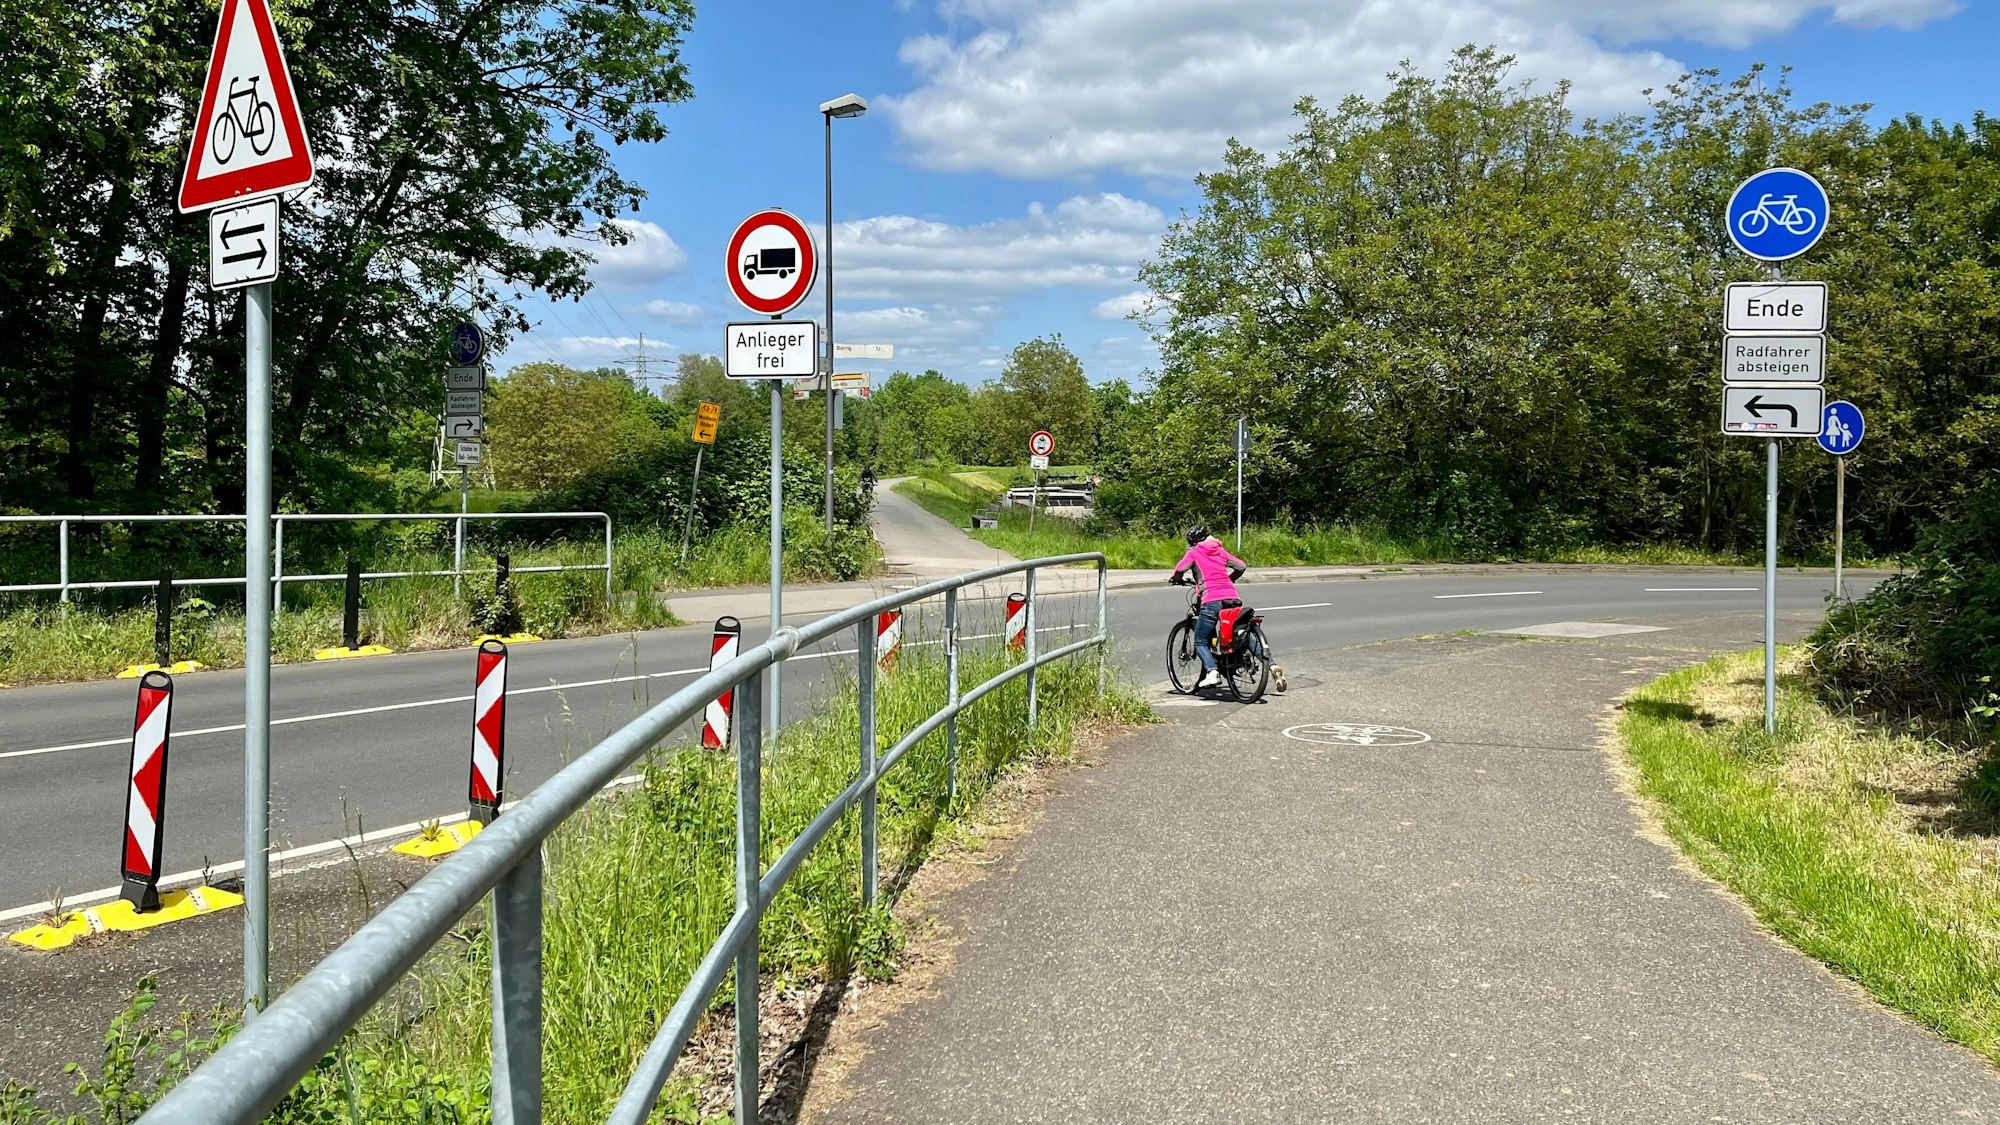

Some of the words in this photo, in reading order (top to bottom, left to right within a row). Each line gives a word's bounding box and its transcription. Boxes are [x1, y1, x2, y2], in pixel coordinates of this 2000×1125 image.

[1747, 299, 1804, 317] Ende
[736, 331, 805, 351] Anlieger
[1736, 346, 1811, 357] Radfahrer
[757, 352, 784, 368] frei
[1737, 361, 1809, 375] absteigen
[453, 373, 474, 383] Ende
